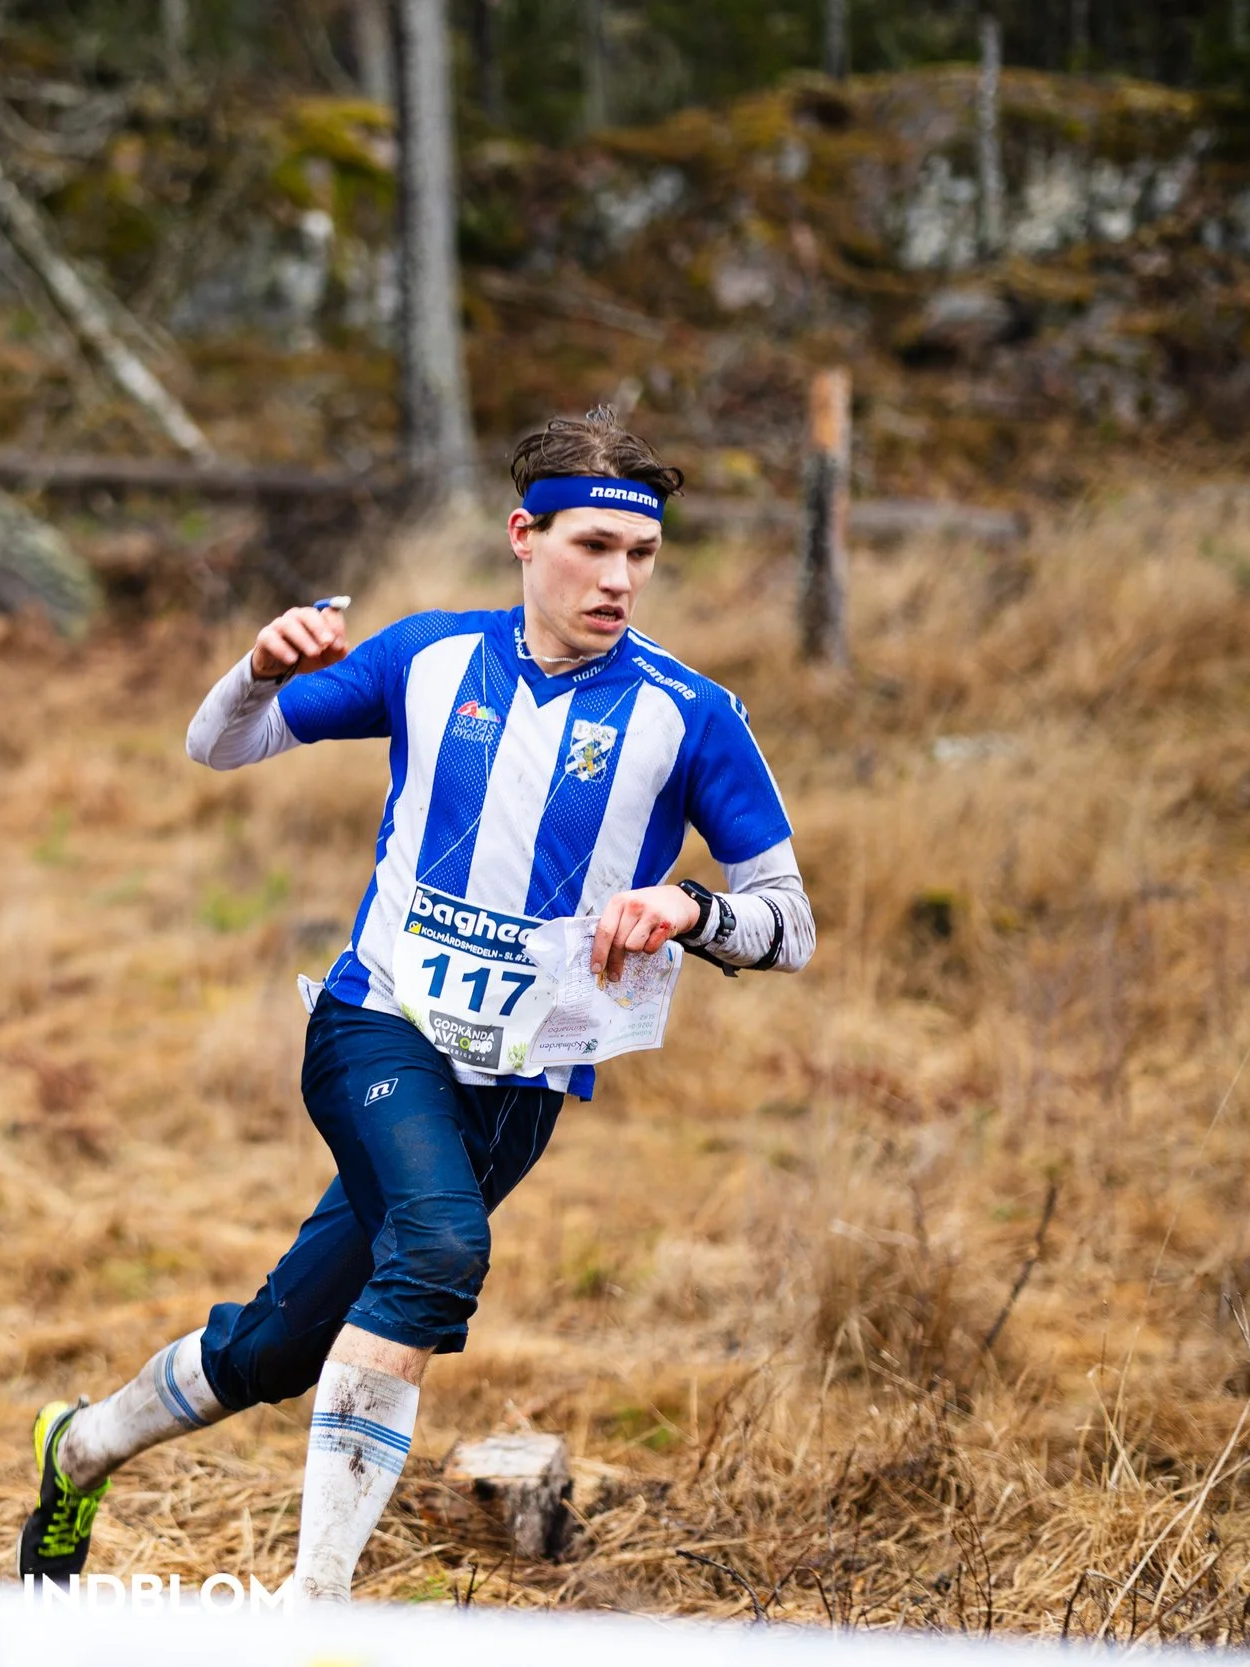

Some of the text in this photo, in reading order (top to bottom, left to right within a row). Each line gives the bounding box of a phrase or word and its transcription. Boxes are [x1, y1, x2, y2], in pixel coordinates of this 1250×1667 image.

[590, 486, 658, 509] noname
[632, 656, 697, 700] noname
[421, 925, 499, 958] KOLMÅRDSMEDELN
[421, 953, 537, 1017] 117
[434, 1018, 494, 1041] GODKÄNDA
